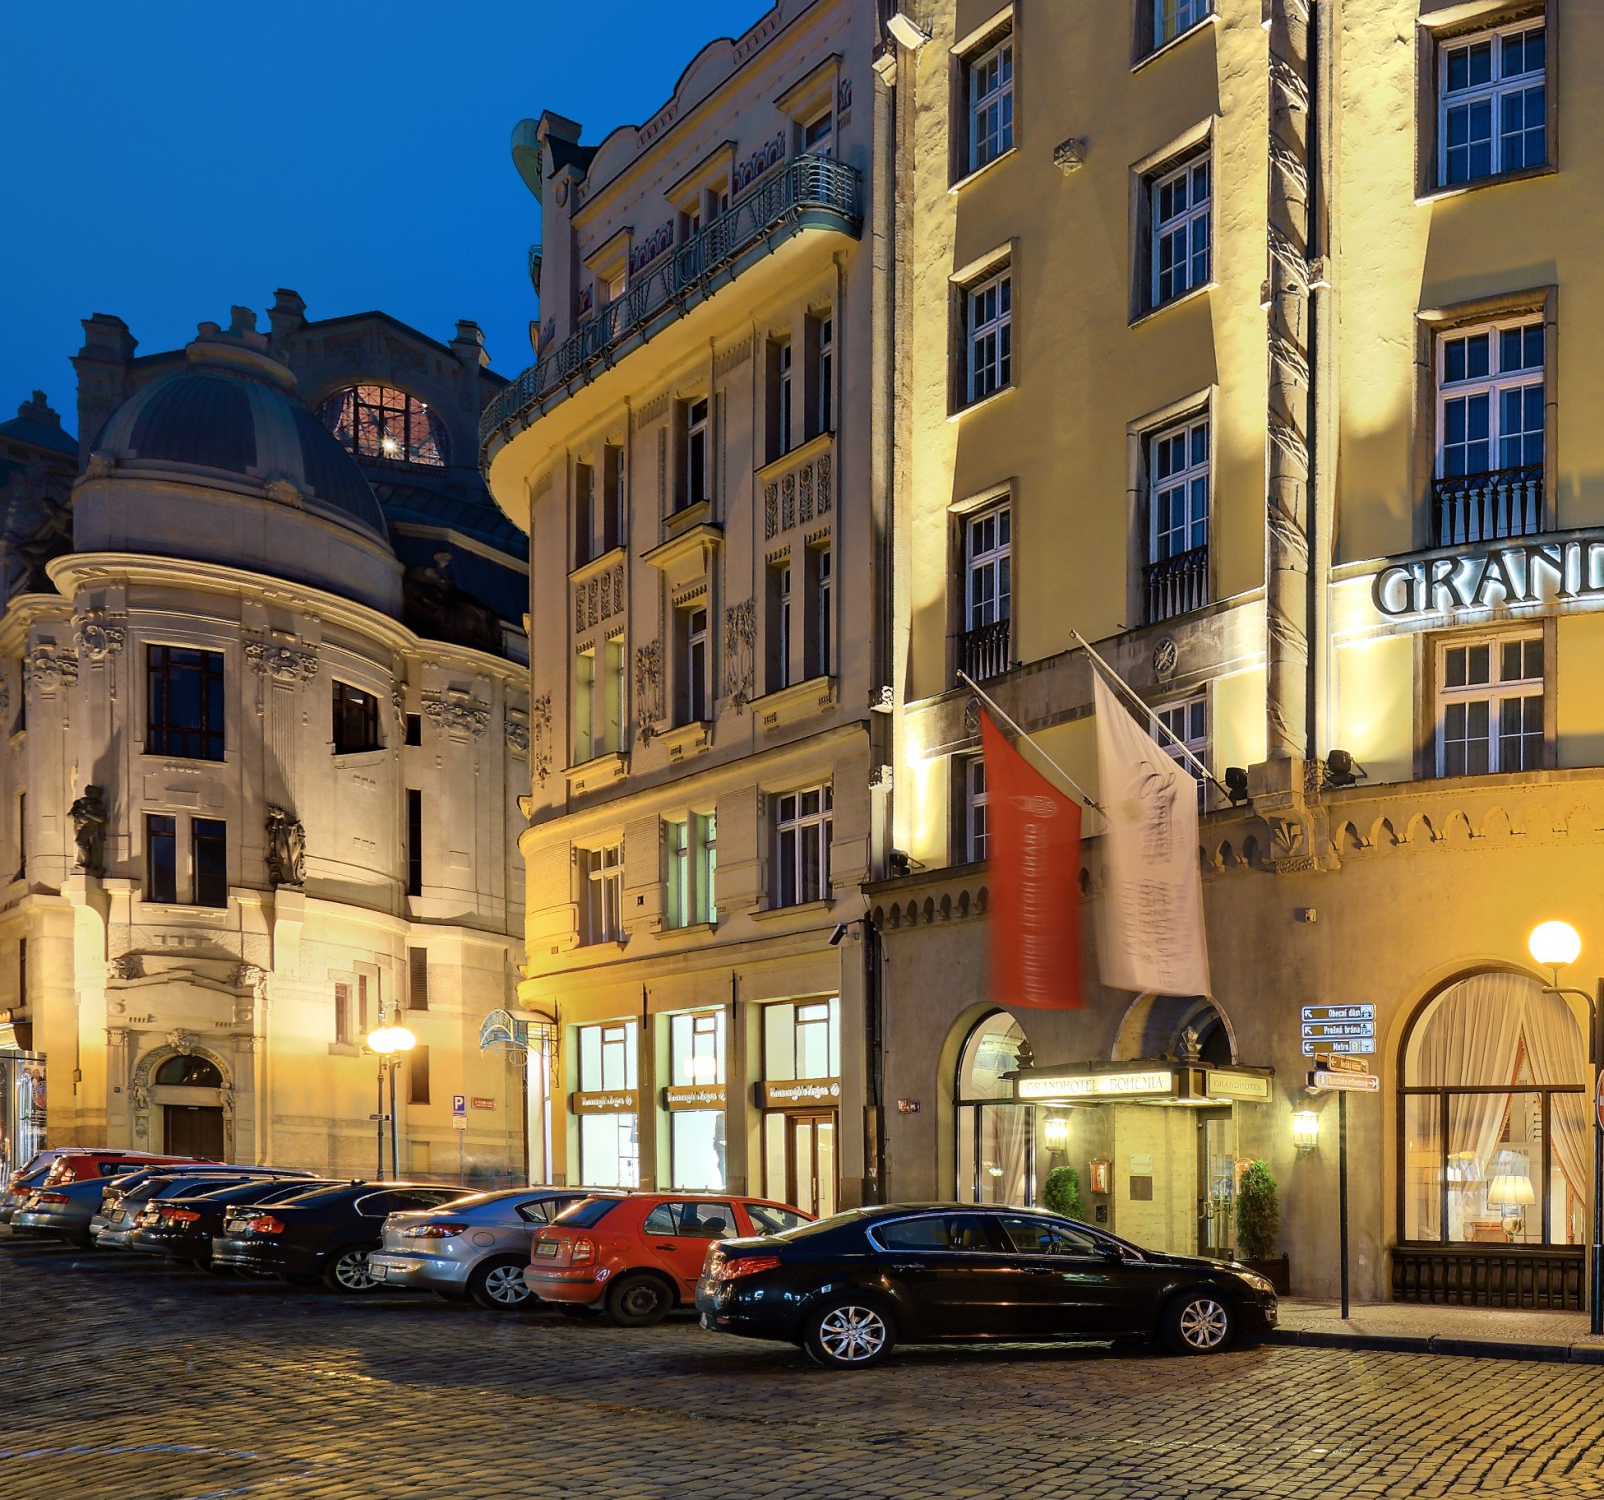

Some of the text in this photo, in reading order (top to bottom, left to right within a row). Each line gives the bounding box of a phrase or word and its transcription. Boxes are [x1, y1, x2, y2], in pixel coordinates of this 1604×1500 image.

[1026, 1076, 1163, 1093] GRANDHOTEL BOHEMIA
[1213, 1080, 1263, 1091] GRANDHOTEL
